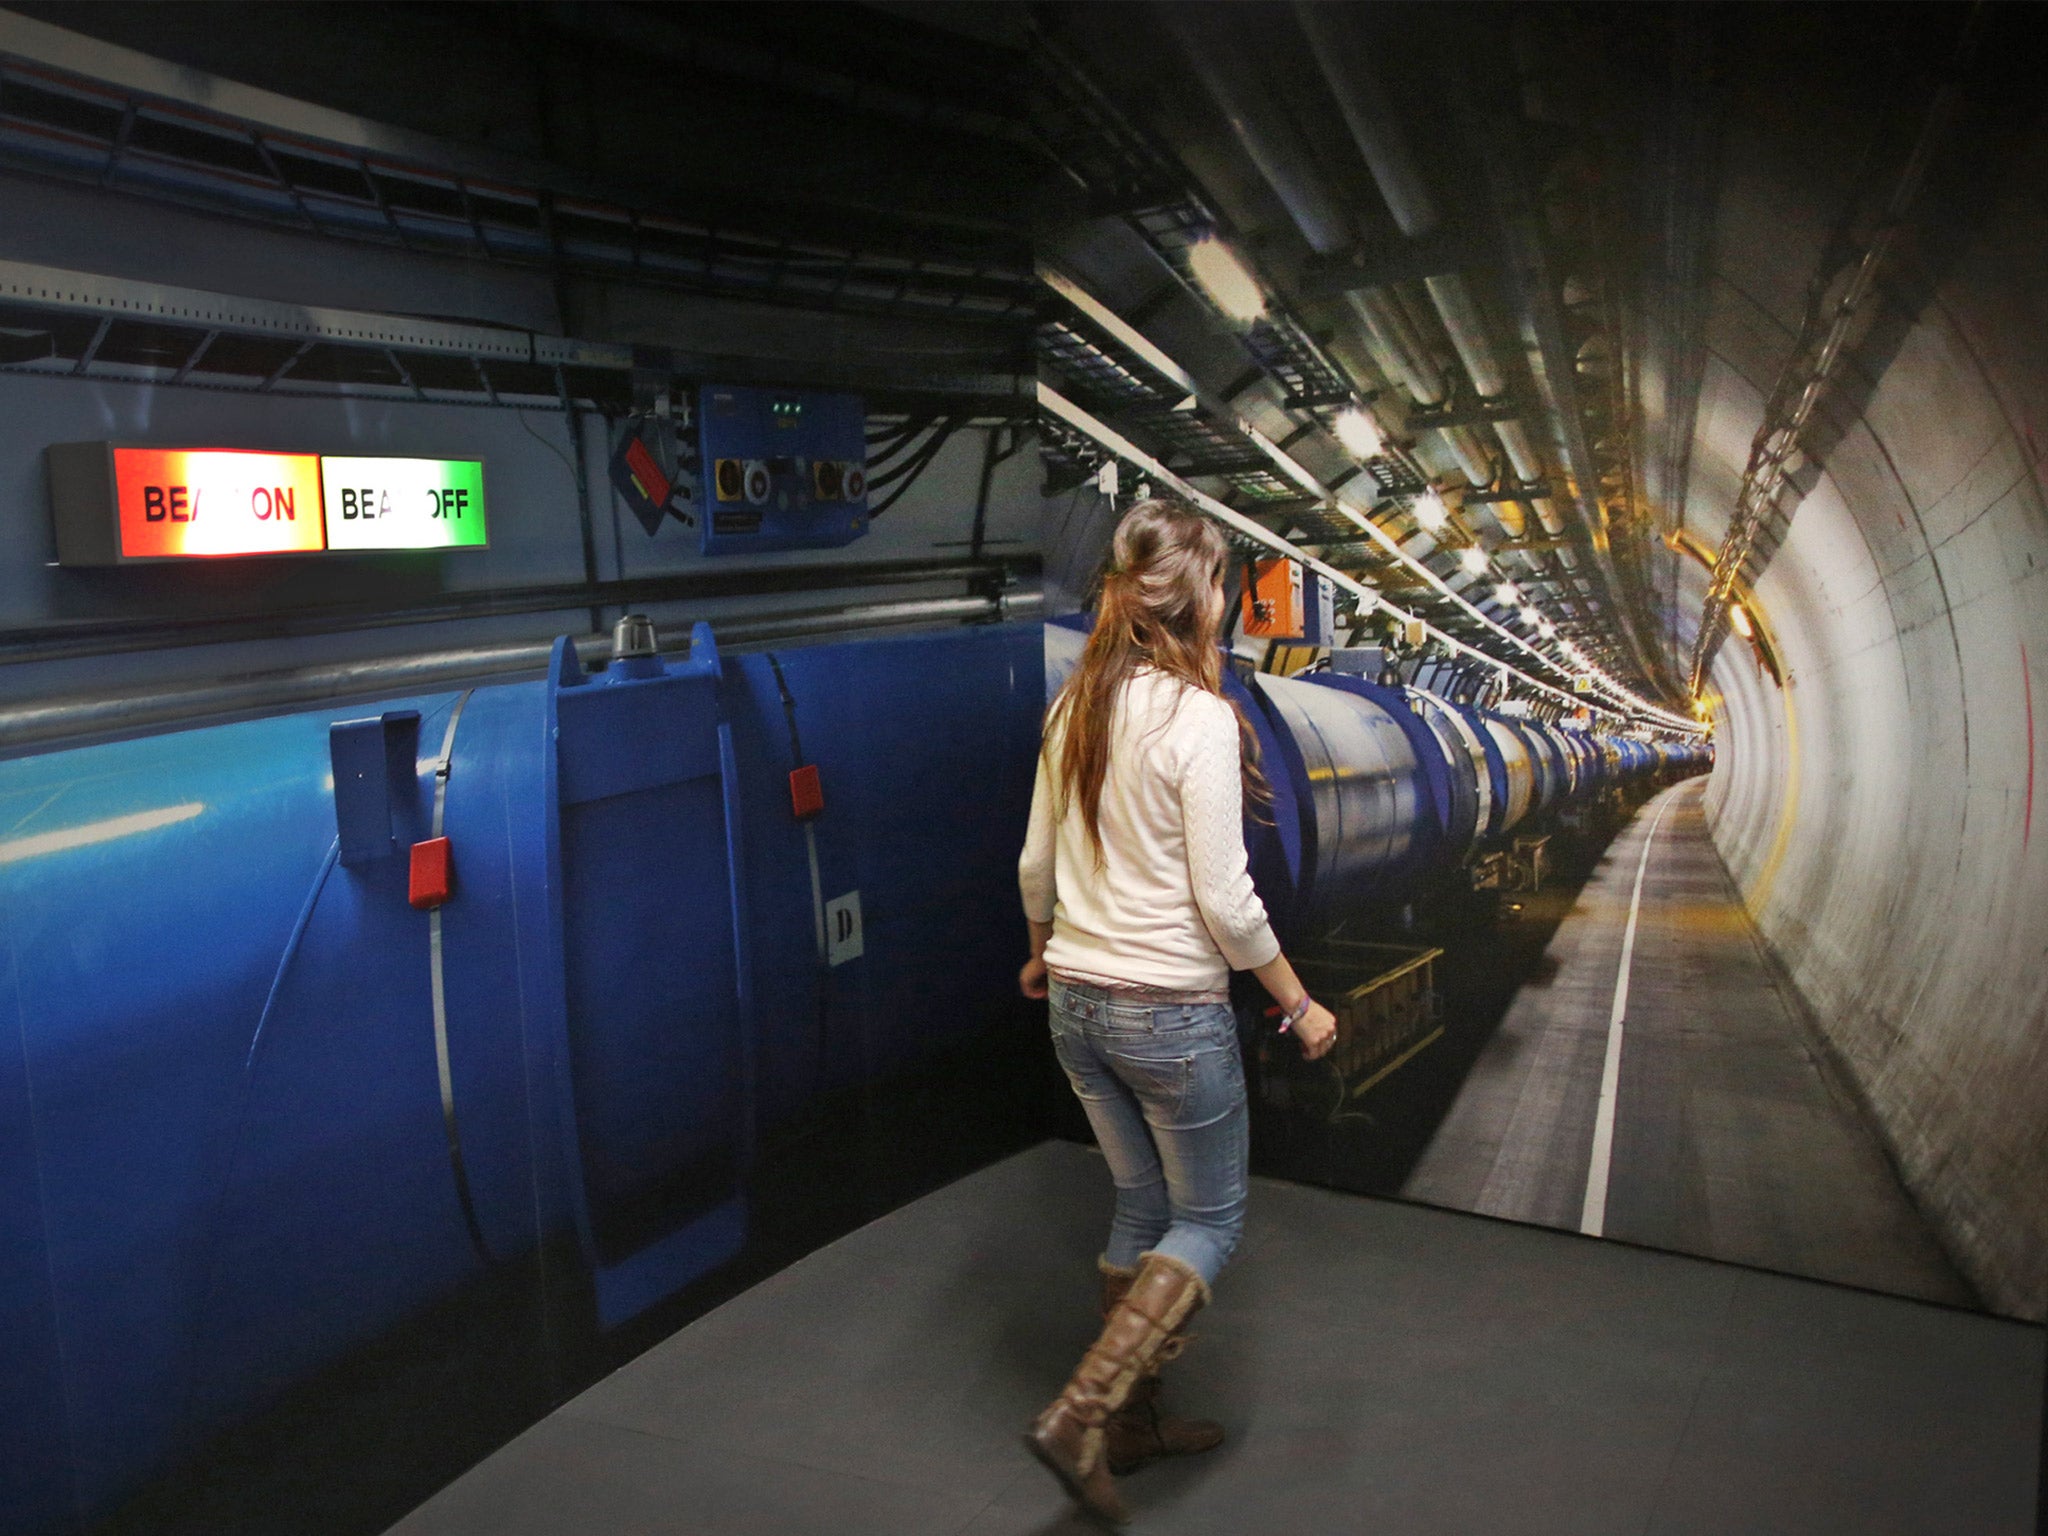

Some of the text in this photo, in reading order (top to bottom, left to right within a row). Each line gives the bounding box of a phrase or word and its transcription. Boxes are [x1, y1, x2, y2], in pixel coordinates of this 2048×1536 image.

[143, 485, 296, 523] BE ON
[341, 487, 398, 520] BEA
[836, 908, 853, 943] D
